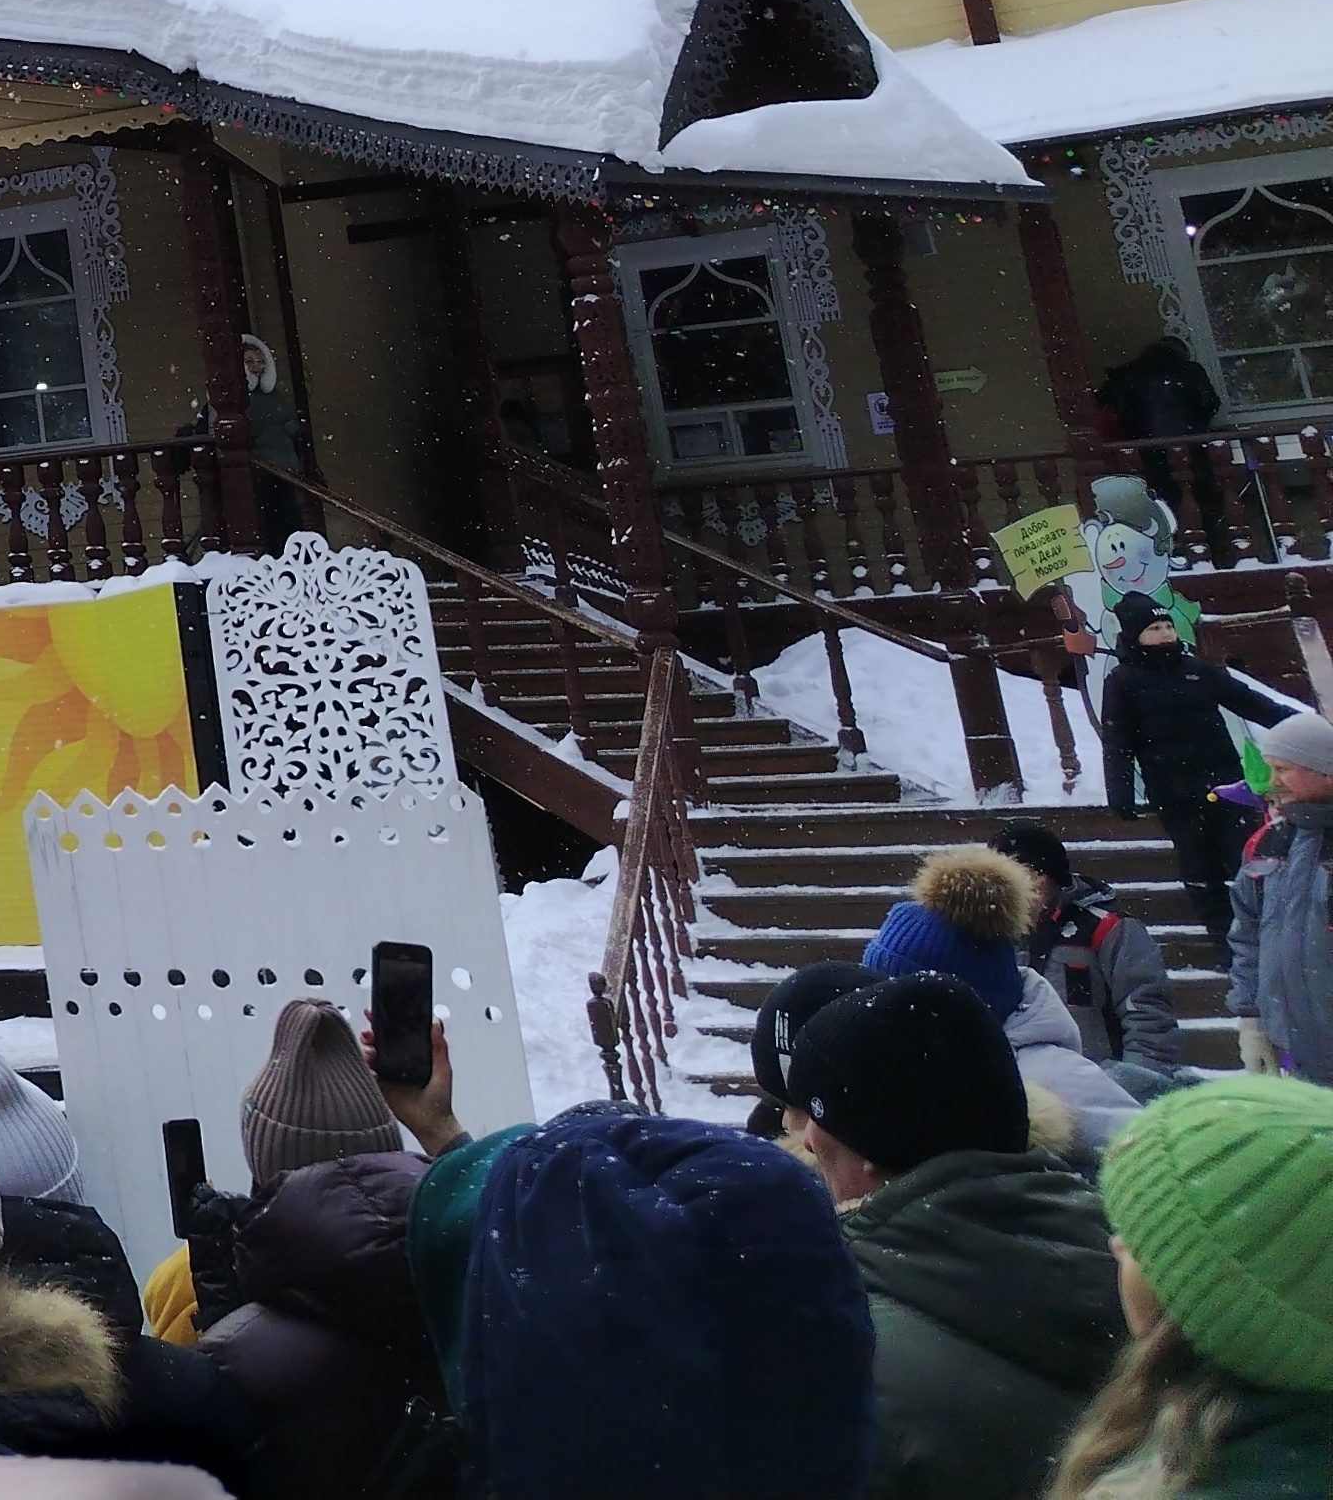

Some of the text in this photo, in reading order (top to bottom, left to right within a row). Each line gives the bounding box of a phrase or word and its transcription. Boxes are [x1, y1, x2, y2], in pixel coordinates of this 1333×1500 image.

[1020, 520, 1049, 541] Добро
[1014, 528, 1067, 558] пожаловать
[1038, 544, 1062, 563] Деду
[1035, 557, 1068, 578] Морозу
